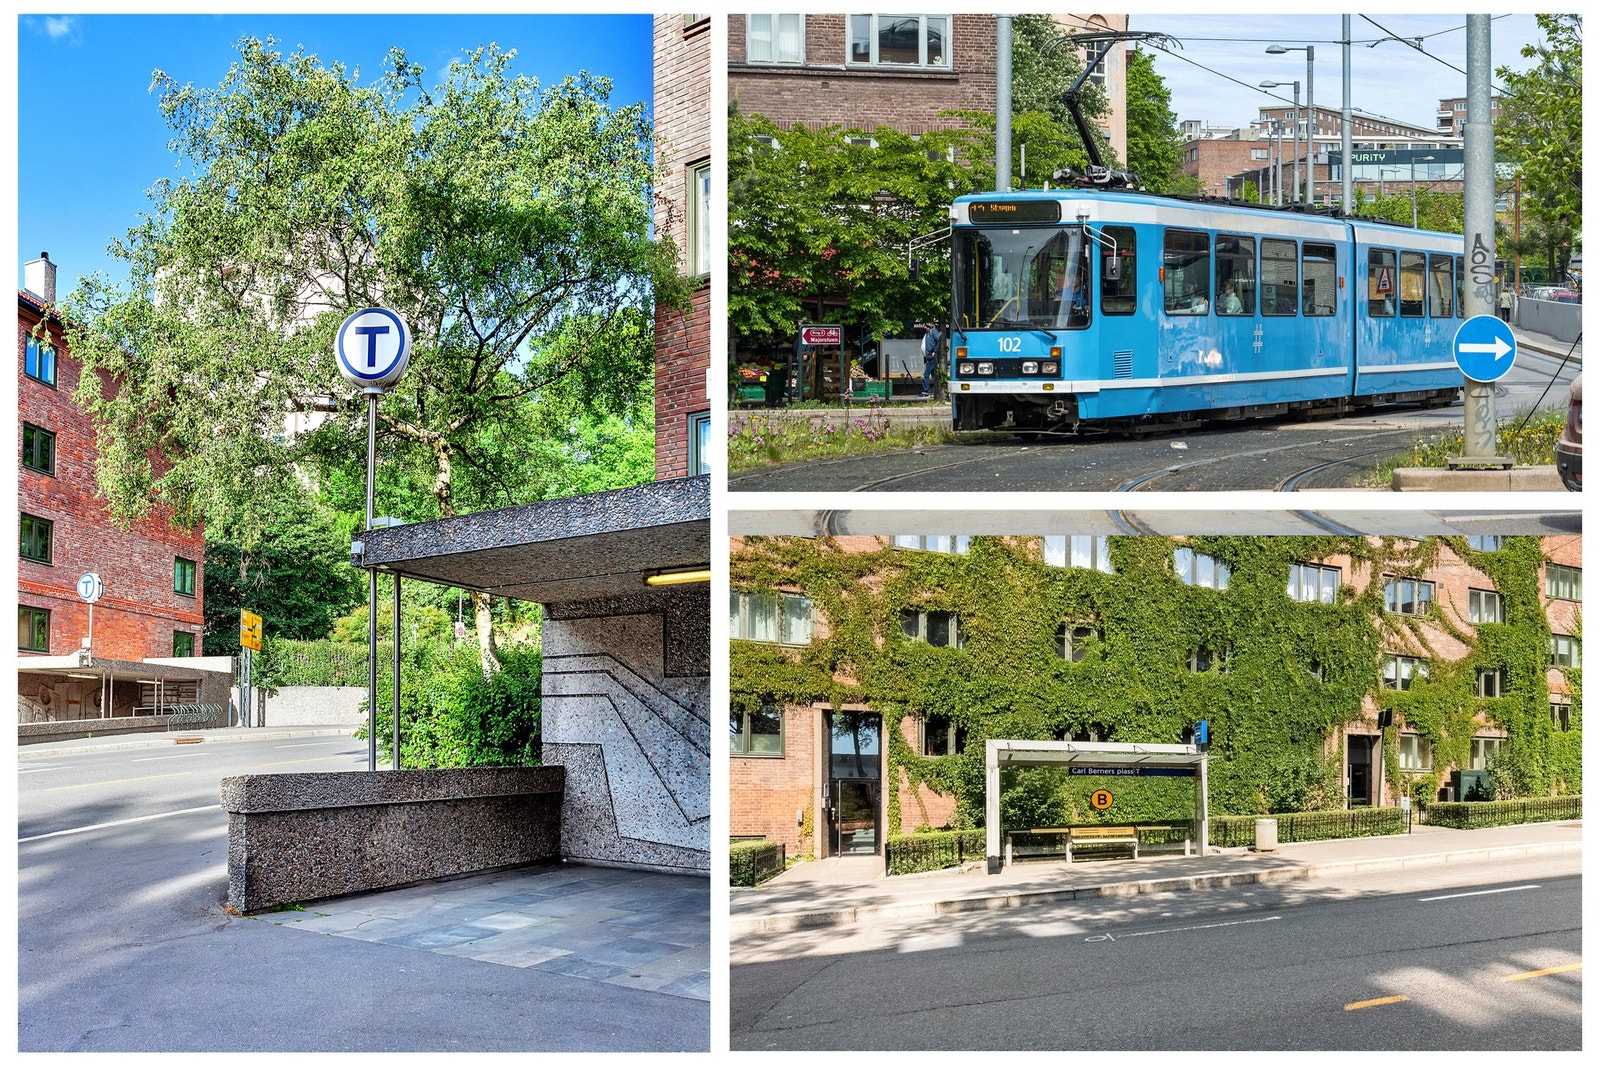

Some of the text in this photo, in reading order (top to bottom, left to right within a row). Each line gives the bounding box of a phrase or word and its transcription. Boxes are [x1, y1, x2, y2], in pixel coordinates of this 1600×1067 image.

[355, 325, 390, 367] T
[997, 337, 1022, 352] 102
[82, 580, 91, 594] T
[1071, 767, 1087, 775] Carl
[1088, 767, 1115, 775] Berners
[1116, 768, 1134, 776] plass
[1097, 793, 1107, 805] B
